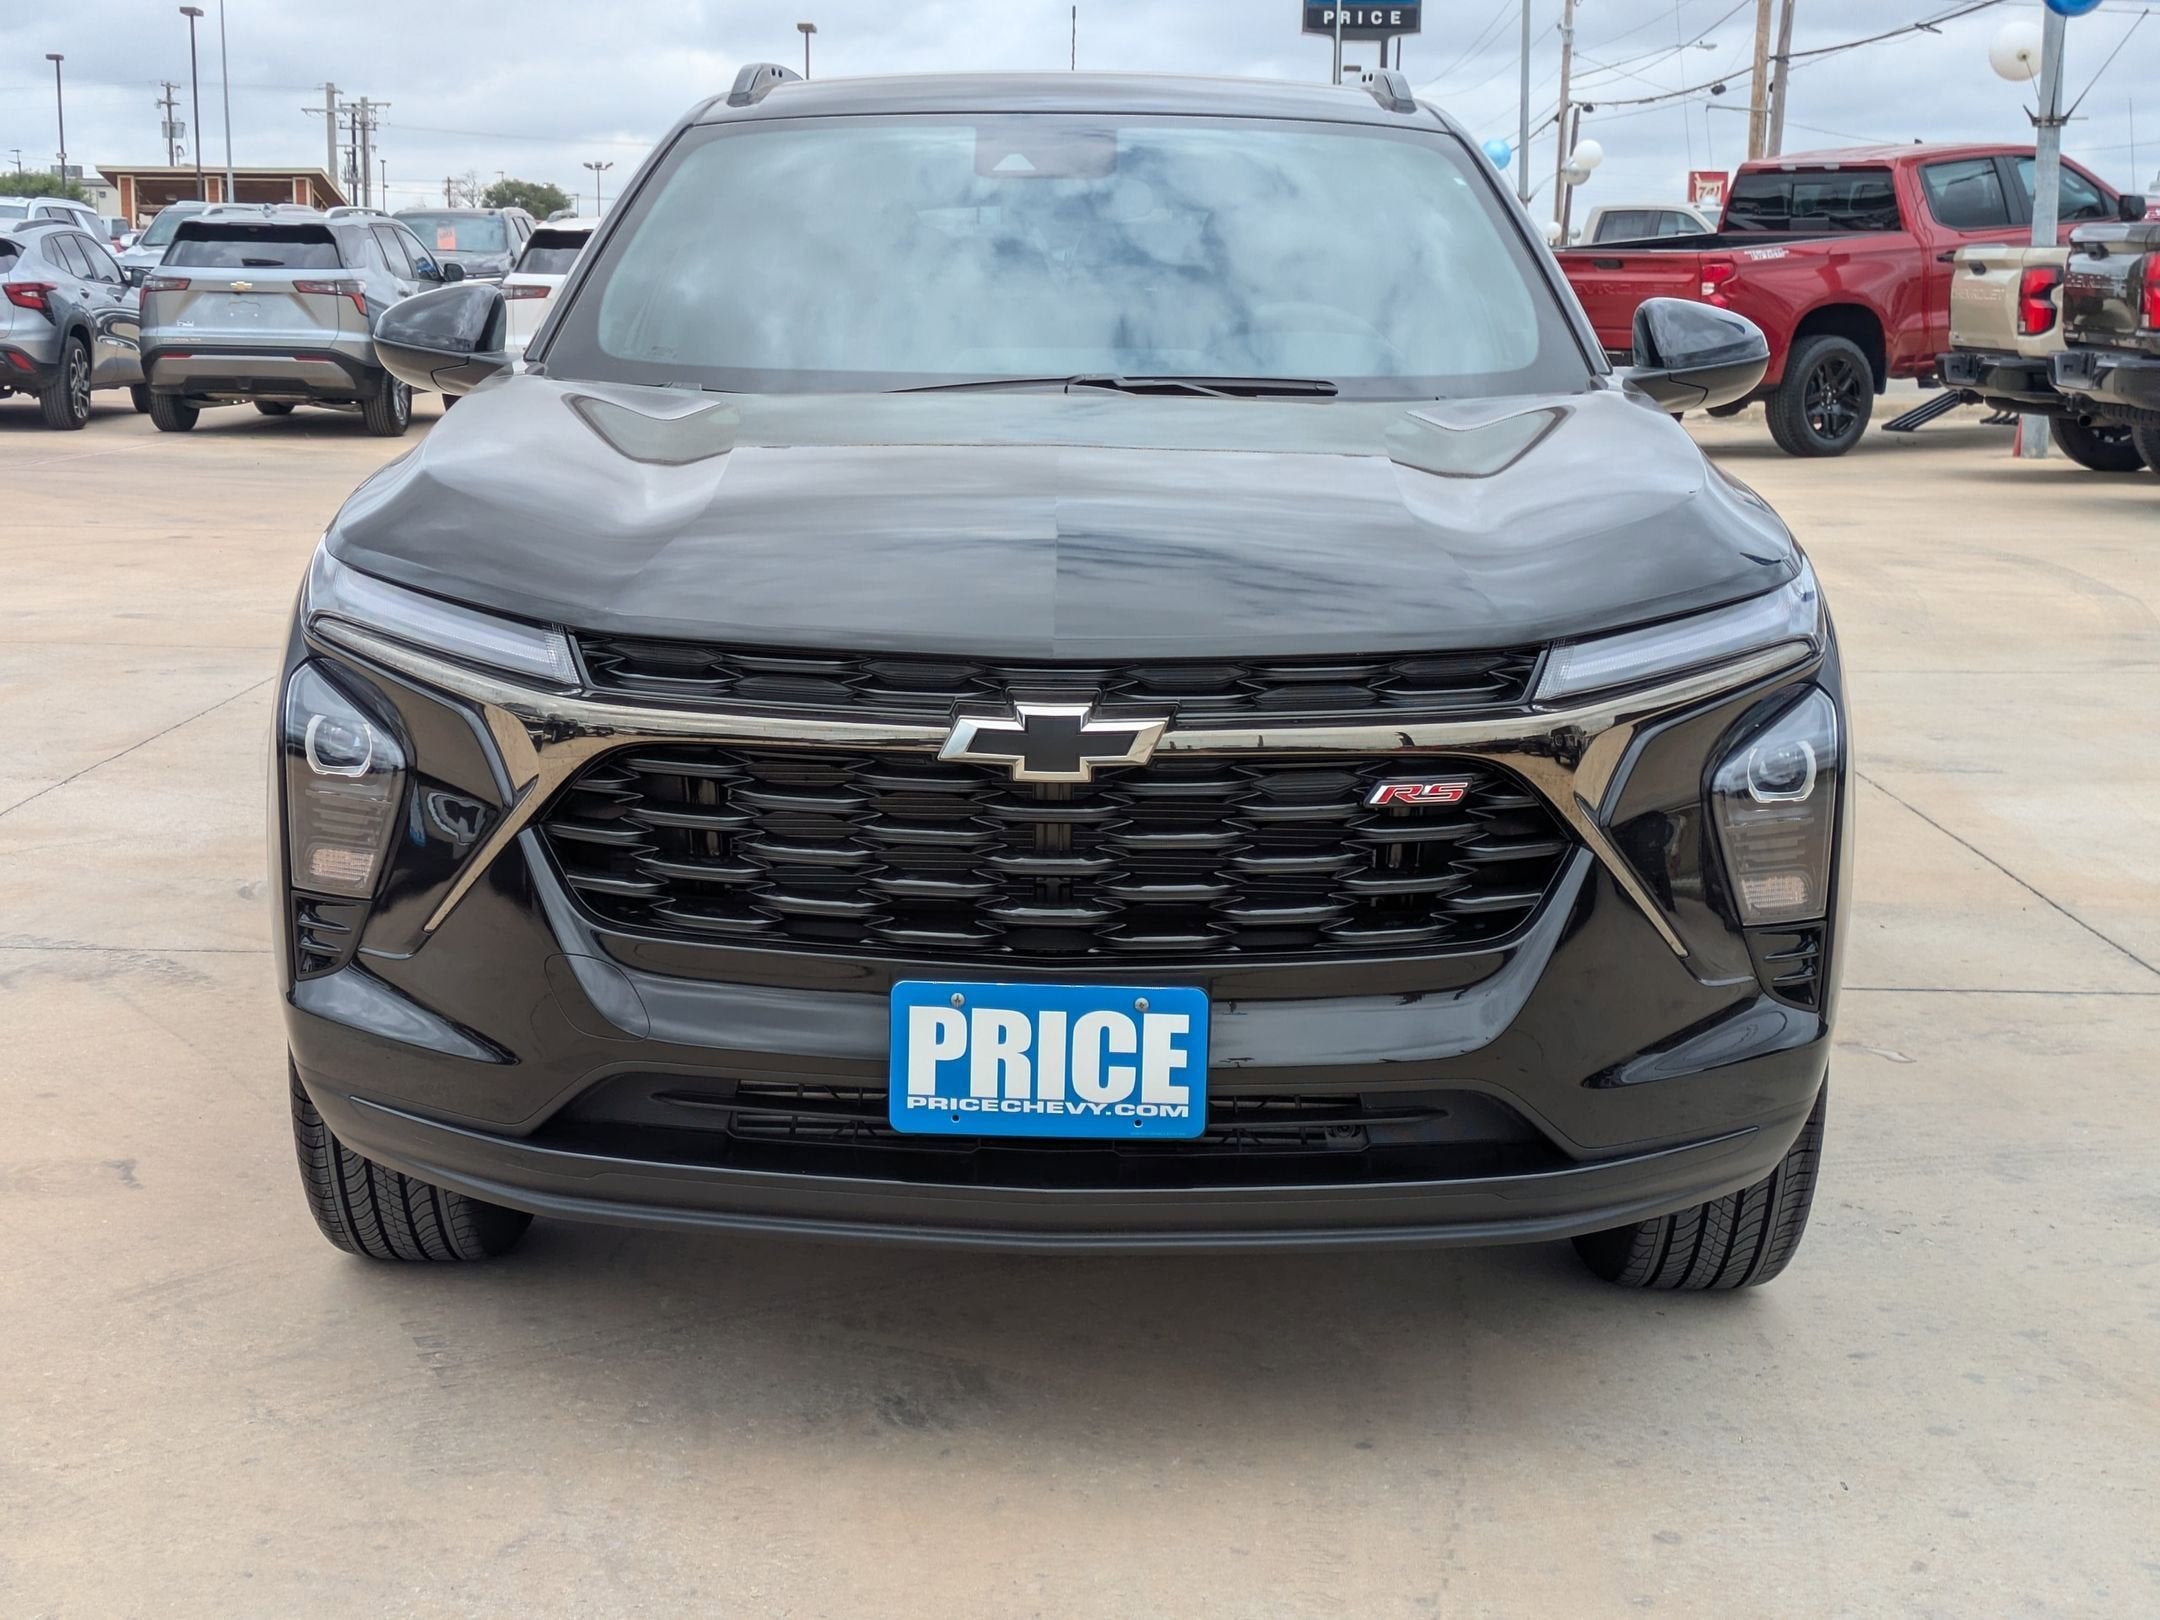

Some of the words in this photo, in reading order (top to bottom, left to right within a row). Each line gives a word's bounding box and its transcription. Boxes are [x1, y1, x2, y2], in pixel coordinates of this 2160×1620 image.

[1323, 10, 1402, 25] PRICE
[1369, 782, 1469, 805] RS
[907, 1005, 1190, 1105] PRICE
[906, 1095, 1190, 1118] PRICECHEVY.COM
